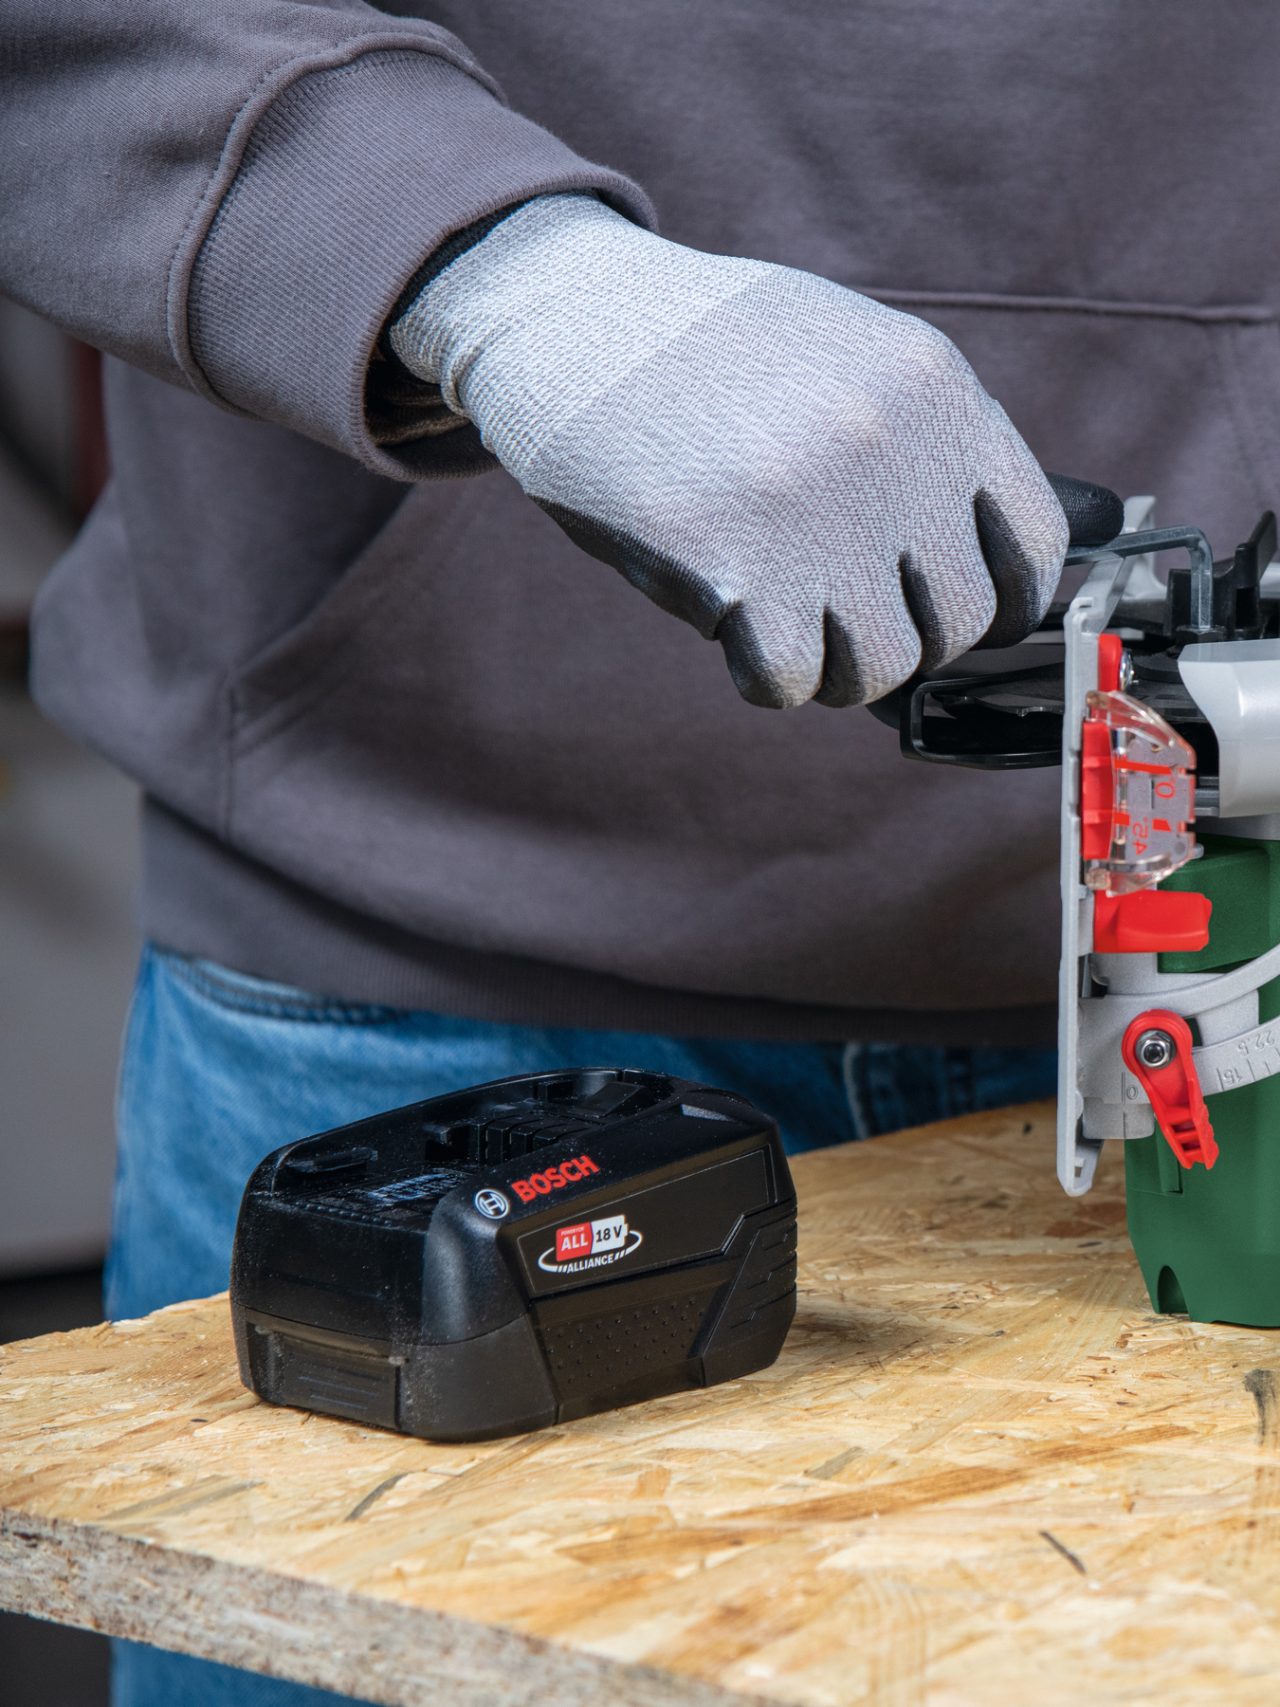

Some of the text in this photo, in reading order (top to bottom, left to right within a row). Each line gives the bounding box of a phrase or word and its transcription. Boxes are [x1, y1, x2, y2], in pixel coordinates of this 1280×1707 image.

[1223, 1068, 1242, 1086] 15
[511, 1155, 600, 1203] BOSCH
[561, 1232, 589, 1252] ALL
[596, 1227, 611, 1243] 18
[613, 1224, 623, 1239] V
[566, 1254, 615, 1274] ALLIANCE
